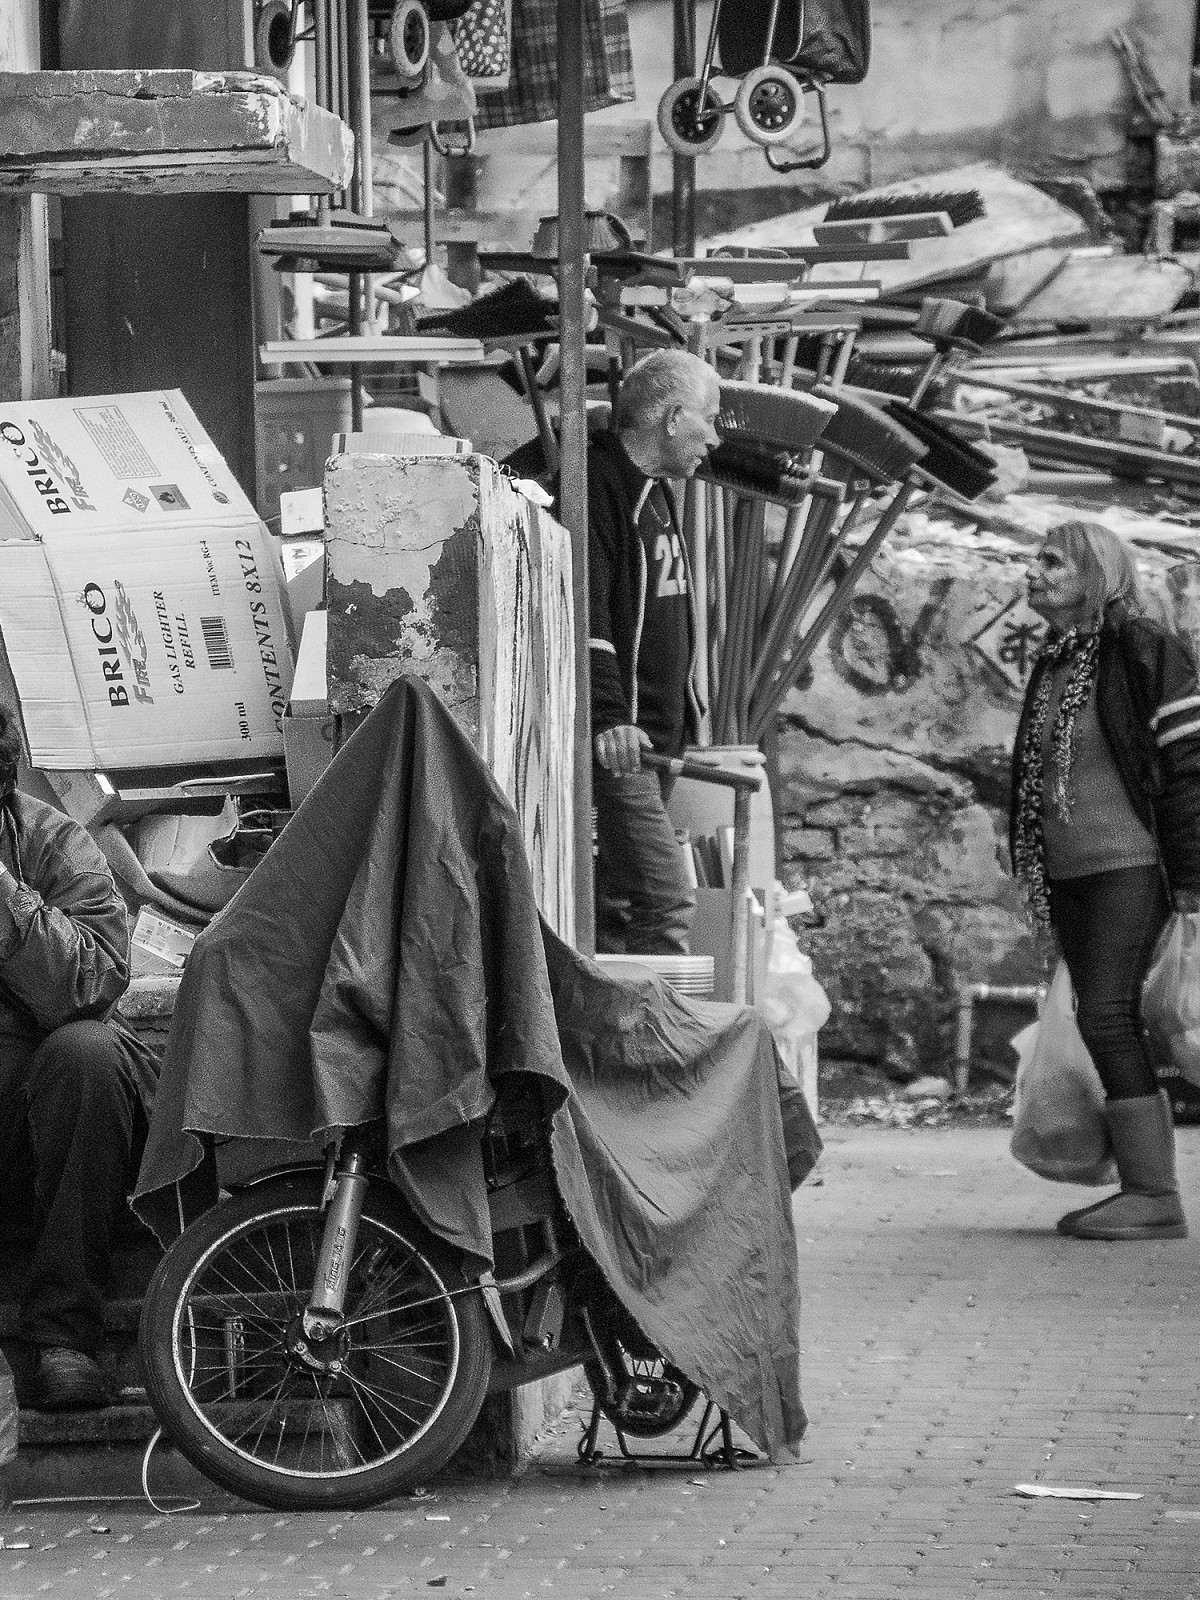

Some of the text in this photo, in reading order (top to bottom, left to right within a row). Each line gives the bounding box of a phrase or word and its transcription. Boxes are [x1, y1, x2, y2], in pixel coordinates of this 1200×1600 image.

[0, 421, 72, 515] BRICO
[209, 574, 220, 596] ITEM
[234, 540, 262, 594] 8X12
[83, 582, 130, 708] BRICO
[153, 590, 185, 694] GAS LIGHTER
[175, 612, 196, 669] REFILL
[234, 702, 252, 741] 300 ml
